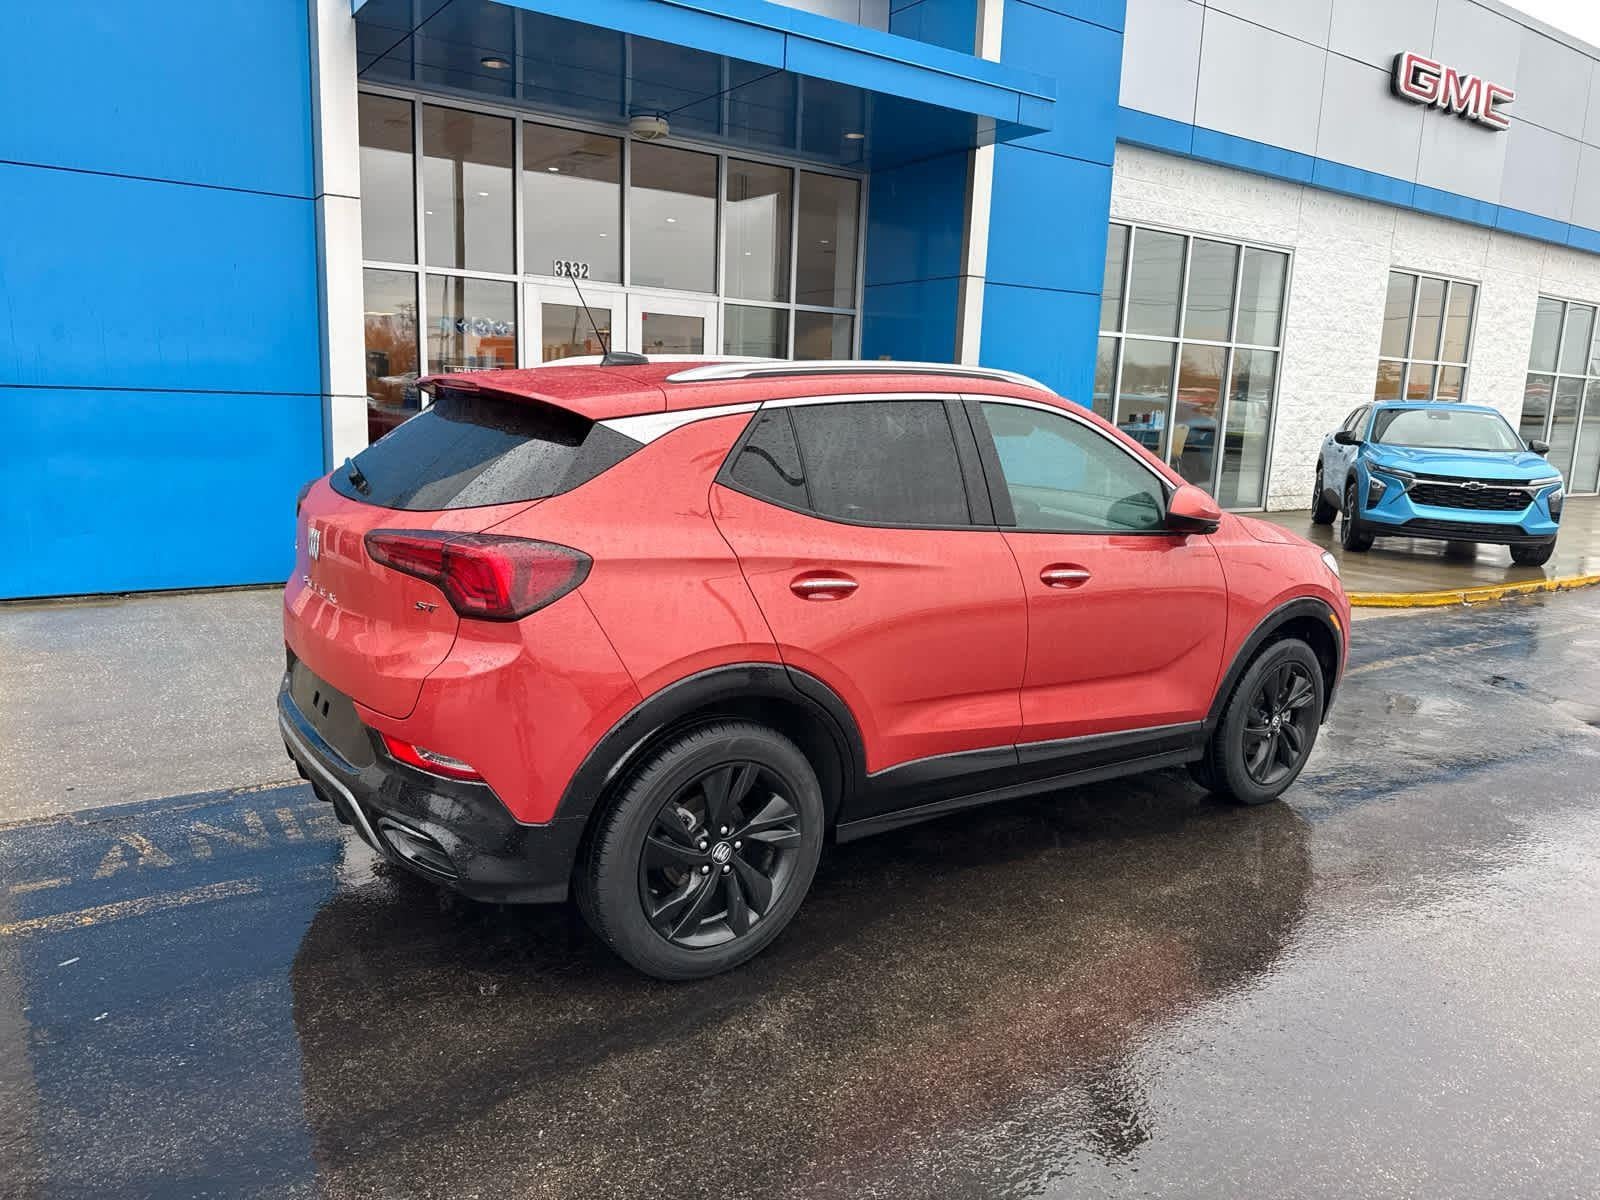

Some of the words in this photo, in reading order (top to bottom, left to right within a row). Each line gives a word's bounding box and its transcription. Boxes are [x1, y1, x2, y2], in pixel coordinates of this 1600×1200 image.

[1392, 50, 1516, 131] GMC
[555, 260, 589, 279] 3232
[415, 601, 439, 613] ST
